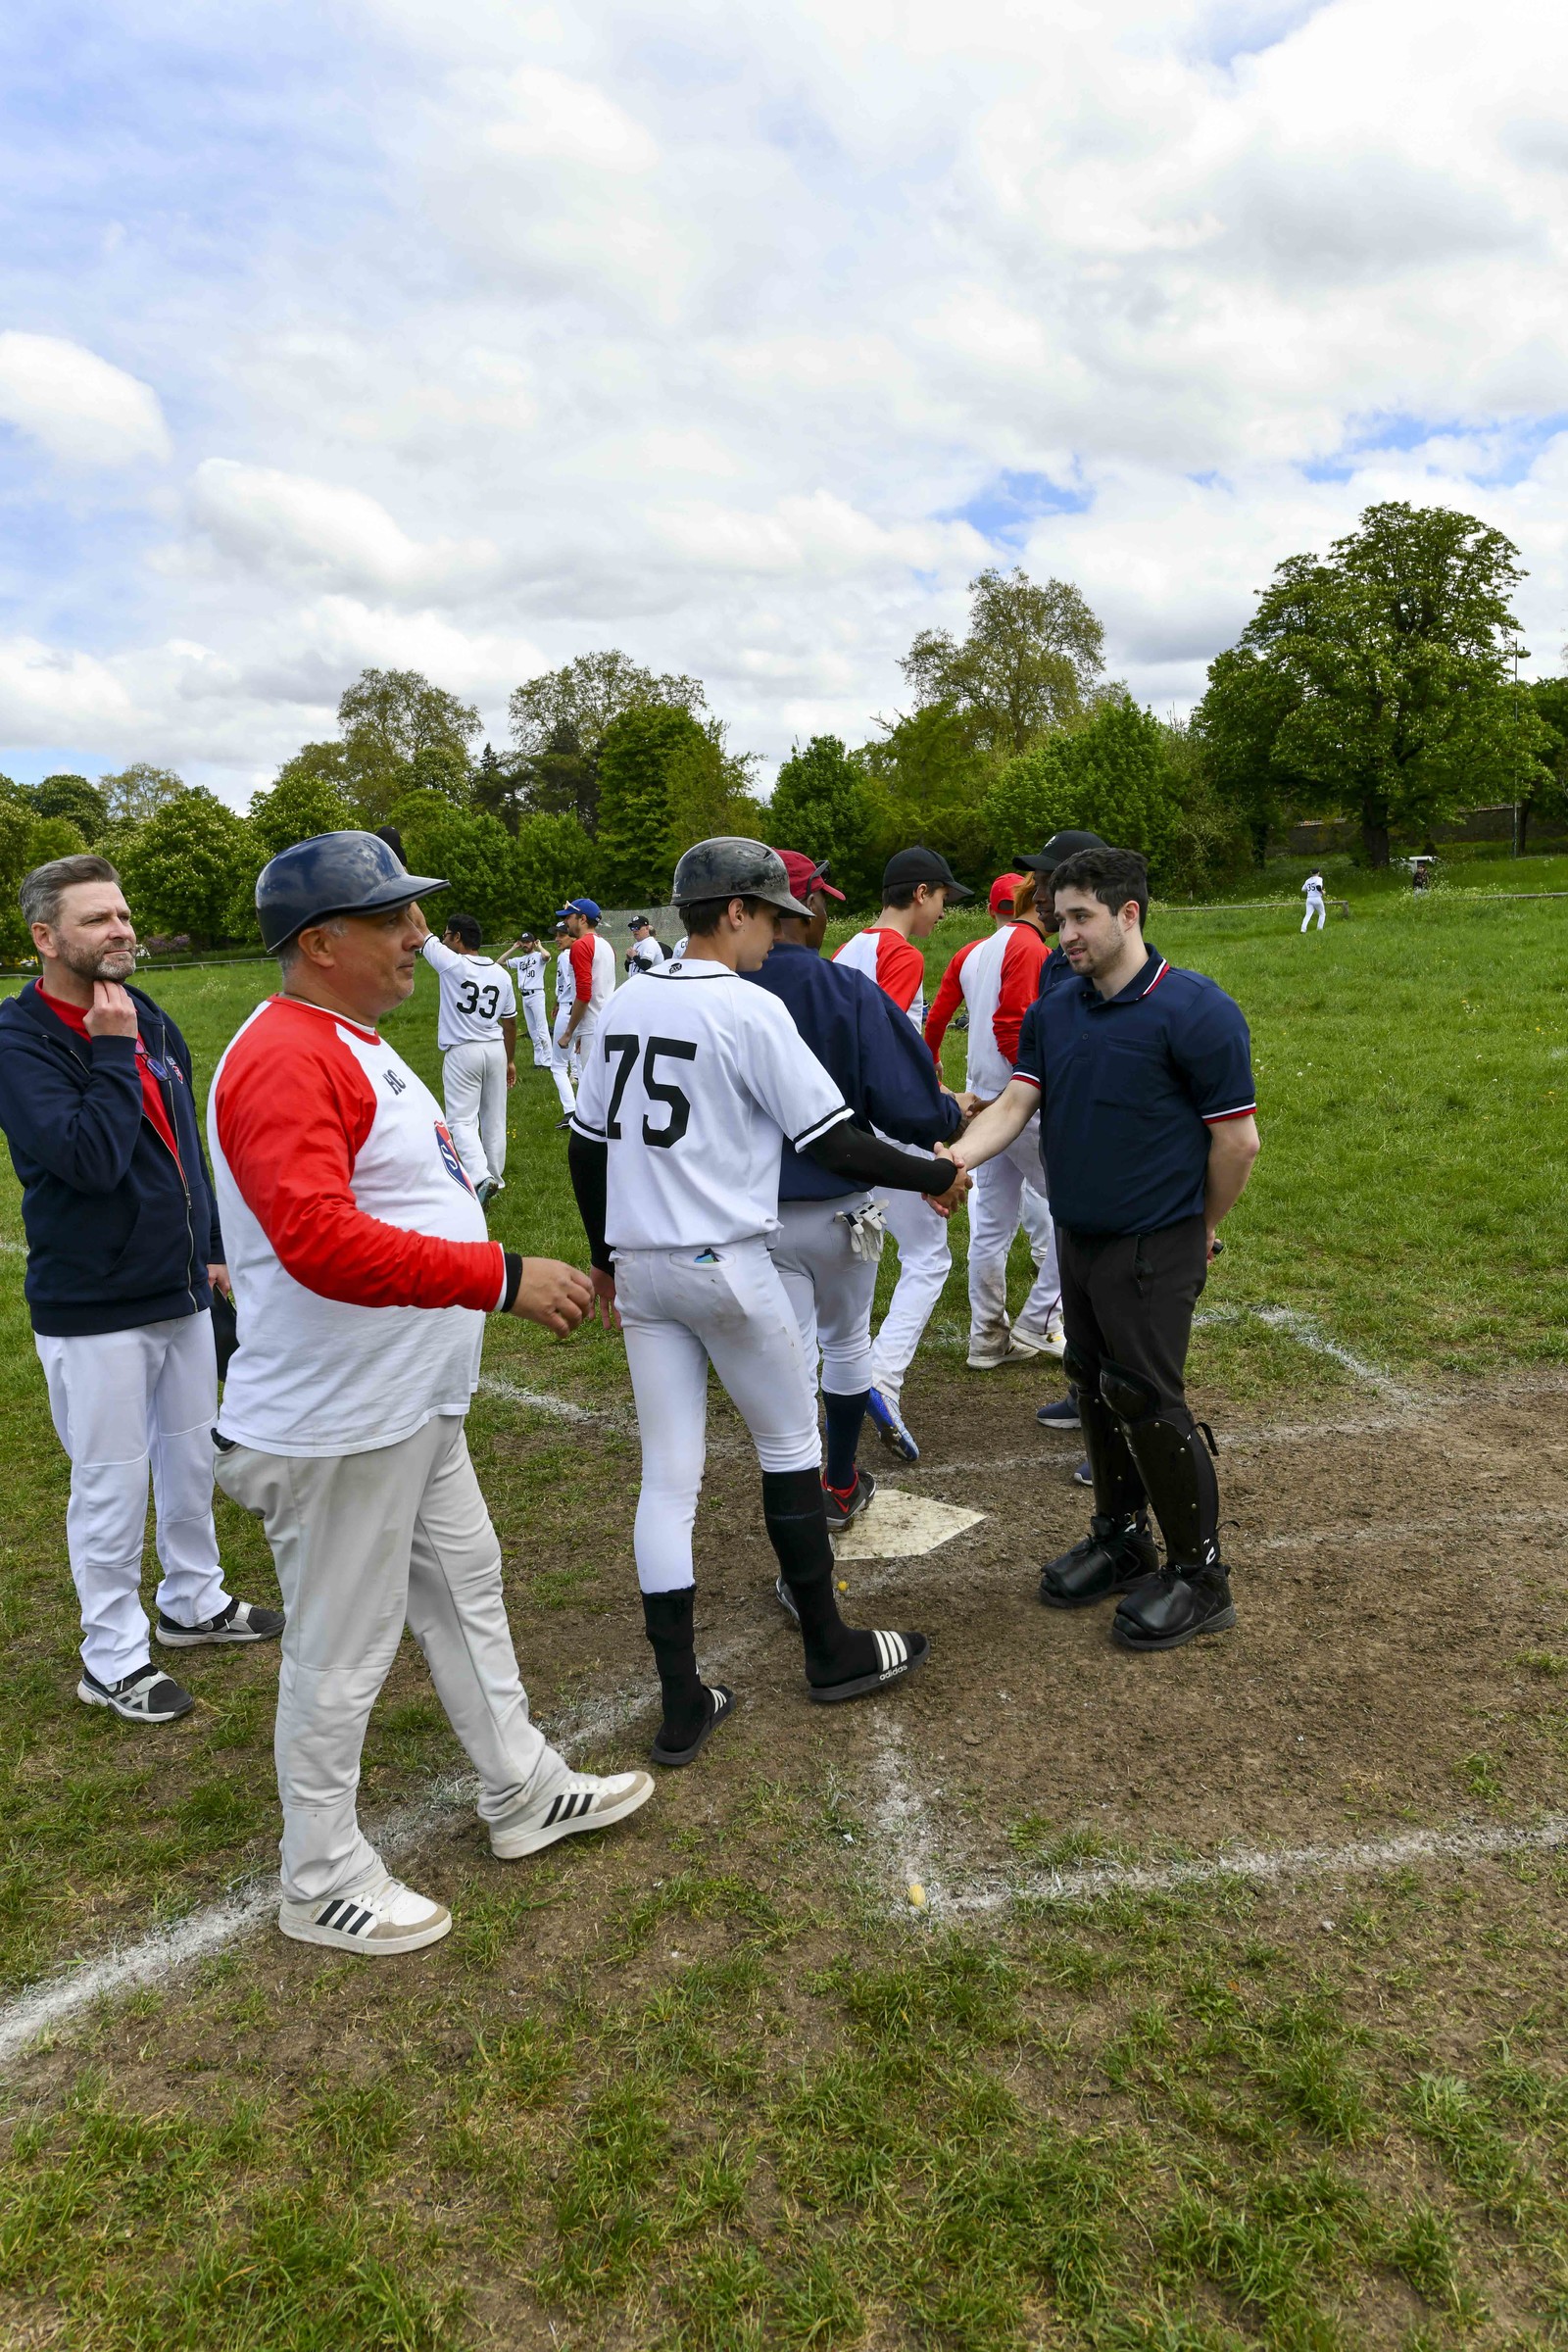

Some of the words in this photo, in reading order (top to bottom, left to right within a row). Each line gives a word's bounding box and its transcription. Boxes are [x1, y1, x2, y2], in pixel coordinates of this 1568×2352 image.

[1306, 882, 1316, 892] 35
[456, 980, 500, 1019] 33
[604, 1034, 698, 1149] 75
[879, 1664, 907, 1681] adidas
